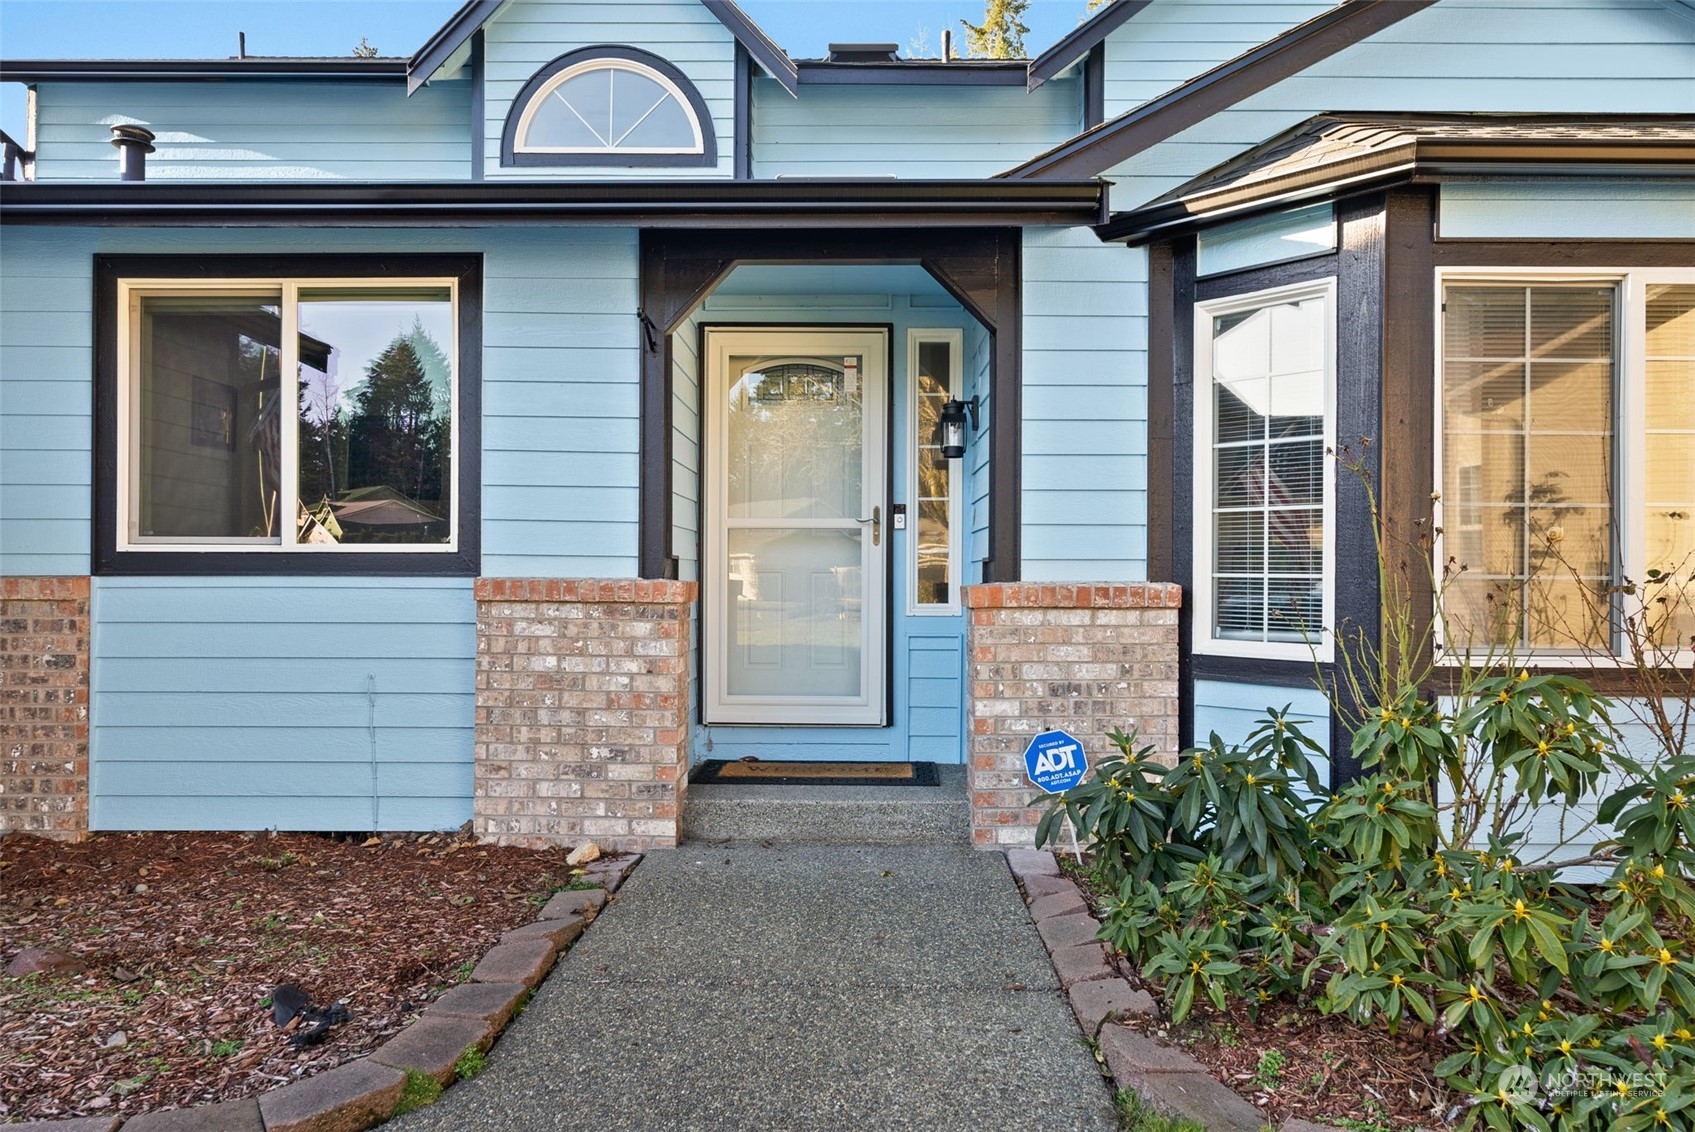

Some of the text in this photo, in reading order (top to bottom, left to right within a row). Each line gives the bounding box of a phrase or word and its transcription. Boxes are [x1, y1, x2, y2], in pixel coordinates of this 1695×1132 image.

[1038, 741, 1058, 749] SECURED
[1034, 744, 1078, 776] ADT
[1037, 770, 1081, 782] 800.ADT.ASAP
